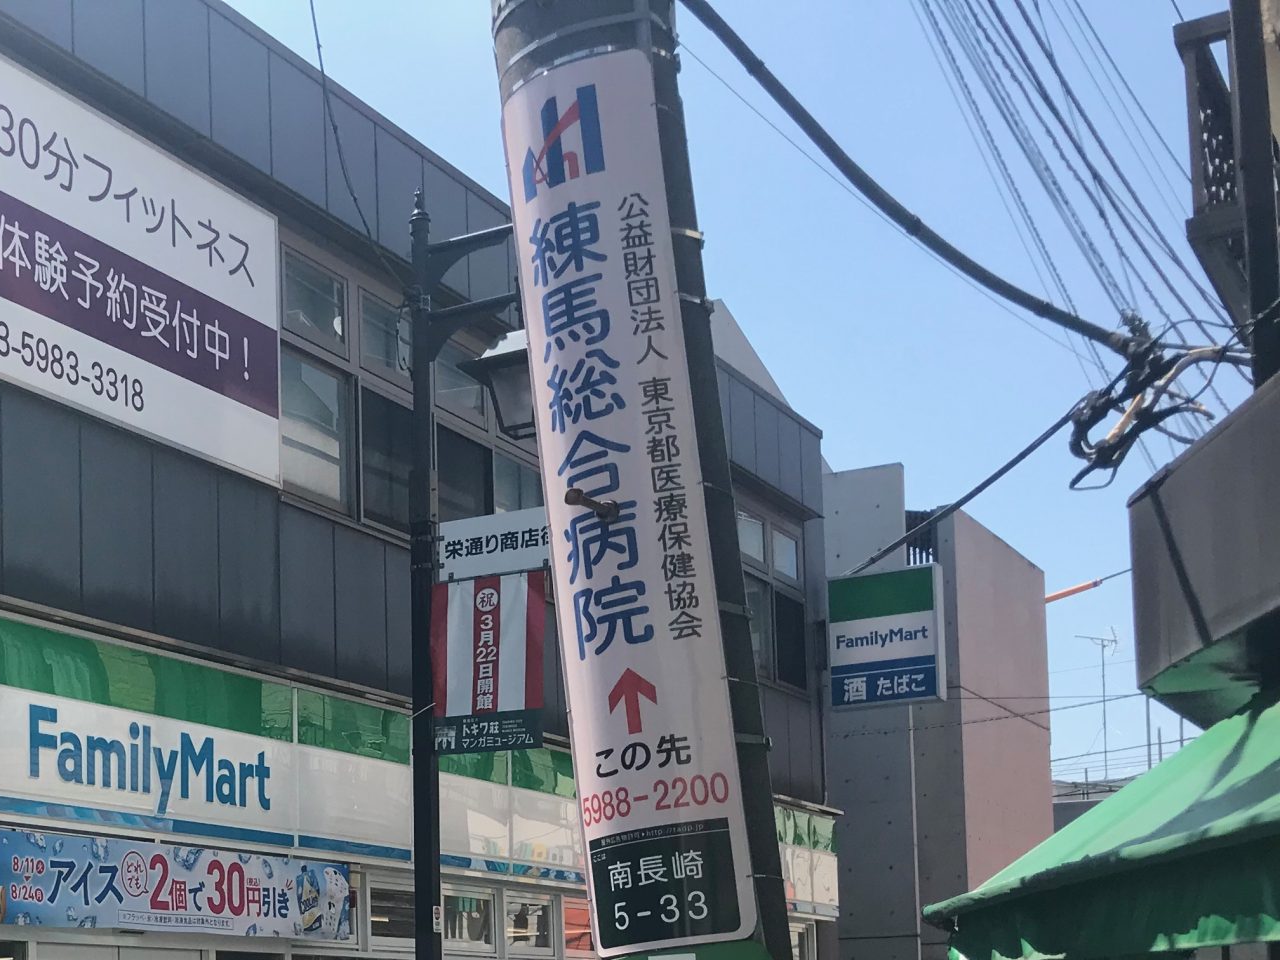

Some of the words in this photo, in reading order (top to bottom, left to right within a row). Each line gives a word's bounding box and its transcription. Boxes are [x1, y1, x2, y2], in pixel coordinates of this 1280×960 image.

[618, 192, 669, 365] 公益財団法人
[529, 201, 654, 661] 練馬総合病院
[638, 376, 702, 641] 東京都医療保健協会
[836, 625, 928, 650] FamilyMart
[476, 614, 497, 710] 3月22日開館
[843, 677, 867, 703] 酒
[876, 673, 926, 697] たばこ
[461, 733, 534, 749] マンガミュージアム
[462, 721, 499, 737] トキワ荘
[28, 703, 271, 817] FamilyMart
[596, 734, 692, 778] この先
[583, 772, 729, 827] 5988-2200
[47, 859, 124, 905] アイス
[608, 850, 704, 891] 南長崎
[614, 891, 708, 931] 5-33
